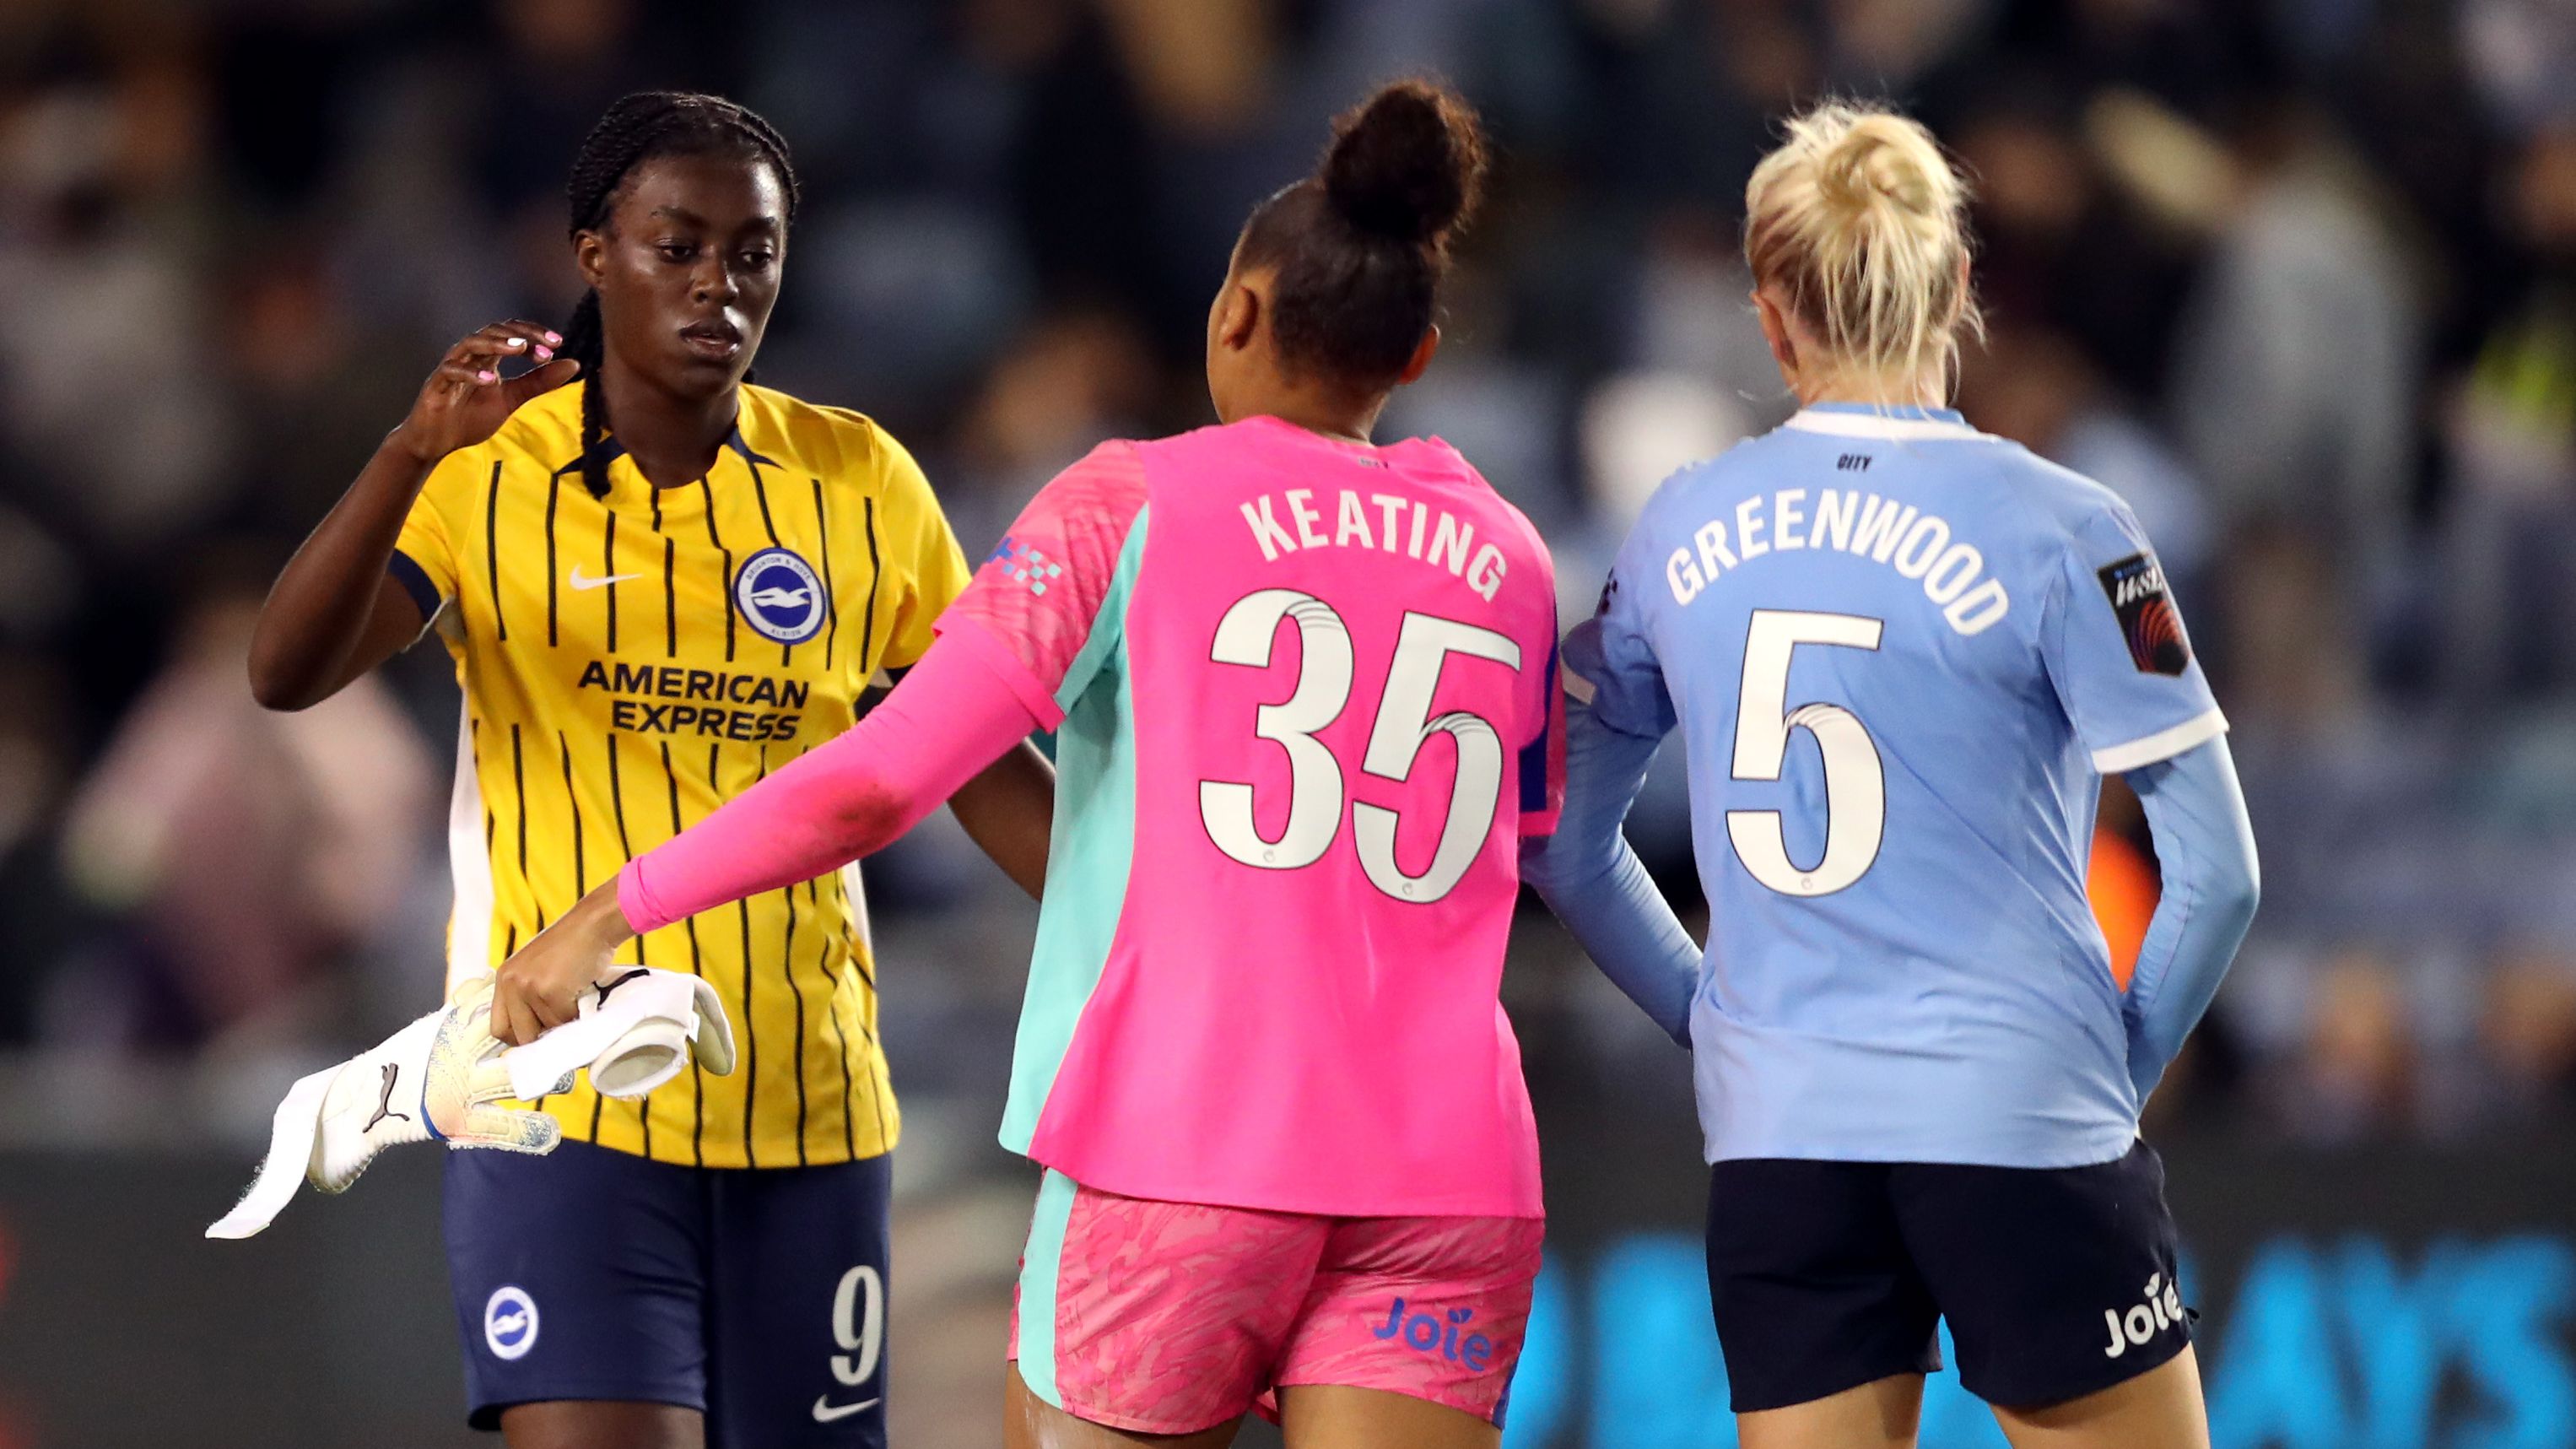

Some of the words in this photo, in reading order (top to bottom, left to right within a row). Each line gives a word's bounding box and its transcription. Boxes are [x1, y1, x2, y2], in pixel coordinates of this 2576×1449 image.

[1838, 453, 1872, 472] CITY
[1239, 489, 1507, 602] KEATING
[1665, 488, 2009, 636] GREENWOOD
[578, 661, 808, 710] AMERICAN
[612, 700, 803, 742] EXPRESS
[1199, 587, 1520, 903] 35
[1725, 608, 1886, 897] 5
[830, 1265, 883, 1385] 9
[1374, 1297, 1492, 1371] Joie
[2104, 1272, 2183, 1358] Joie
